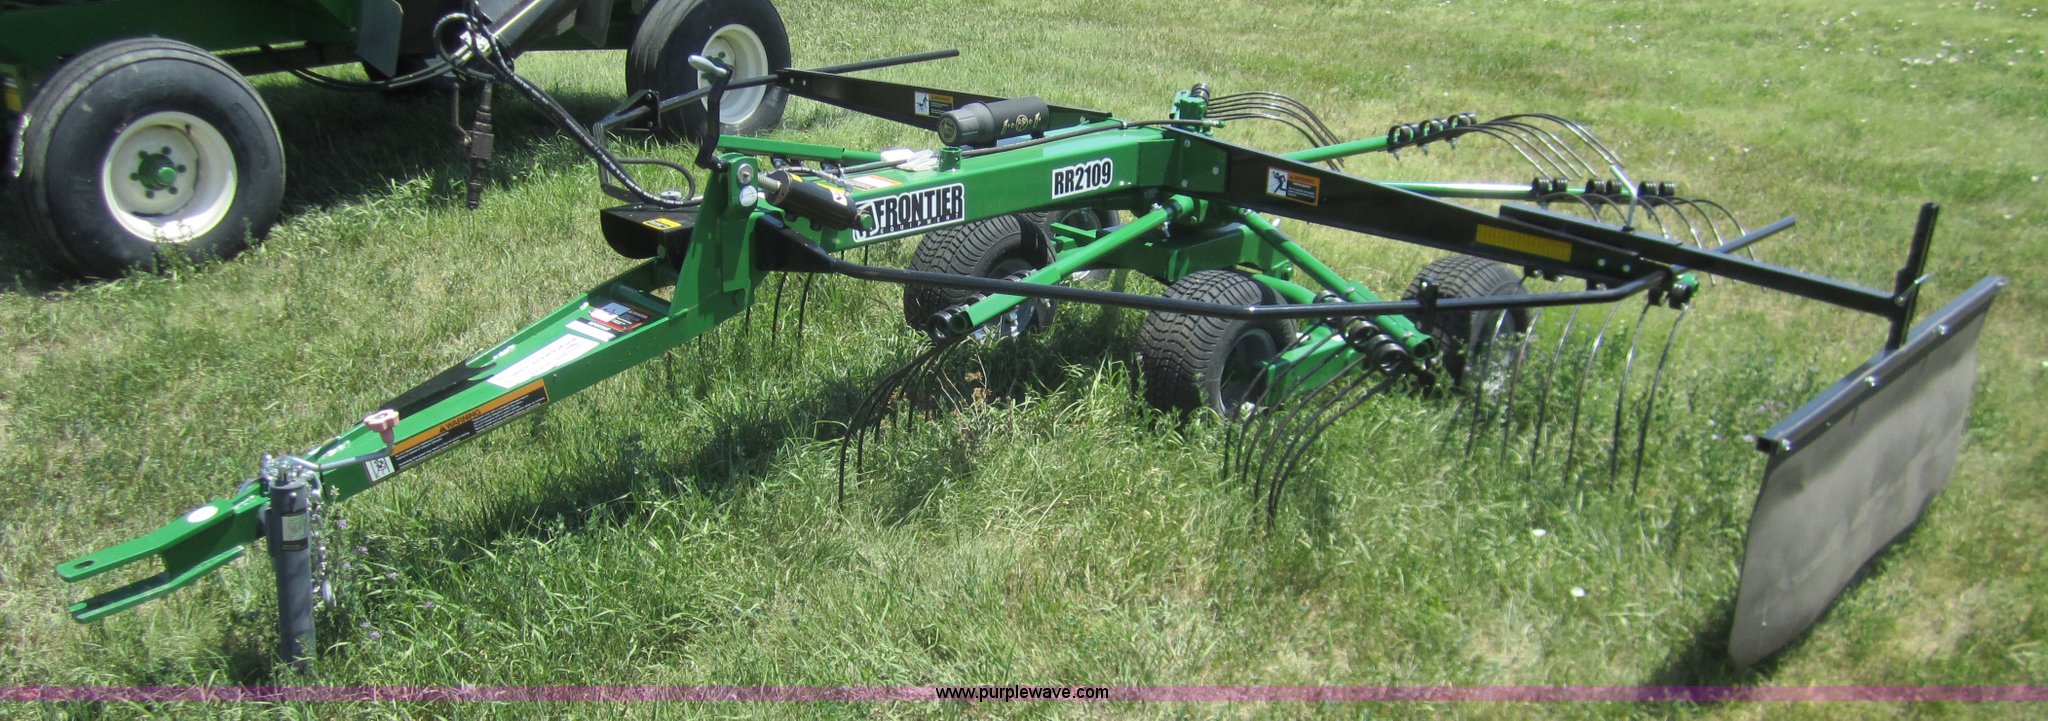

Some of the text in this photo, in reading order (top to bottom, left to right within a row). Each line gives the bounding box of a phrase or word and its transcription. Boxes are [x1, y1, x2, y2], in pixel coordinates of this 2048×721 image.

[1054, 161, 1111, 195] RR2109
[874, 186, 963, 229] FRONTIER
[880, 213, 960, 234] EQUIPMENT
[446, 409, 481, 429] WARNING
